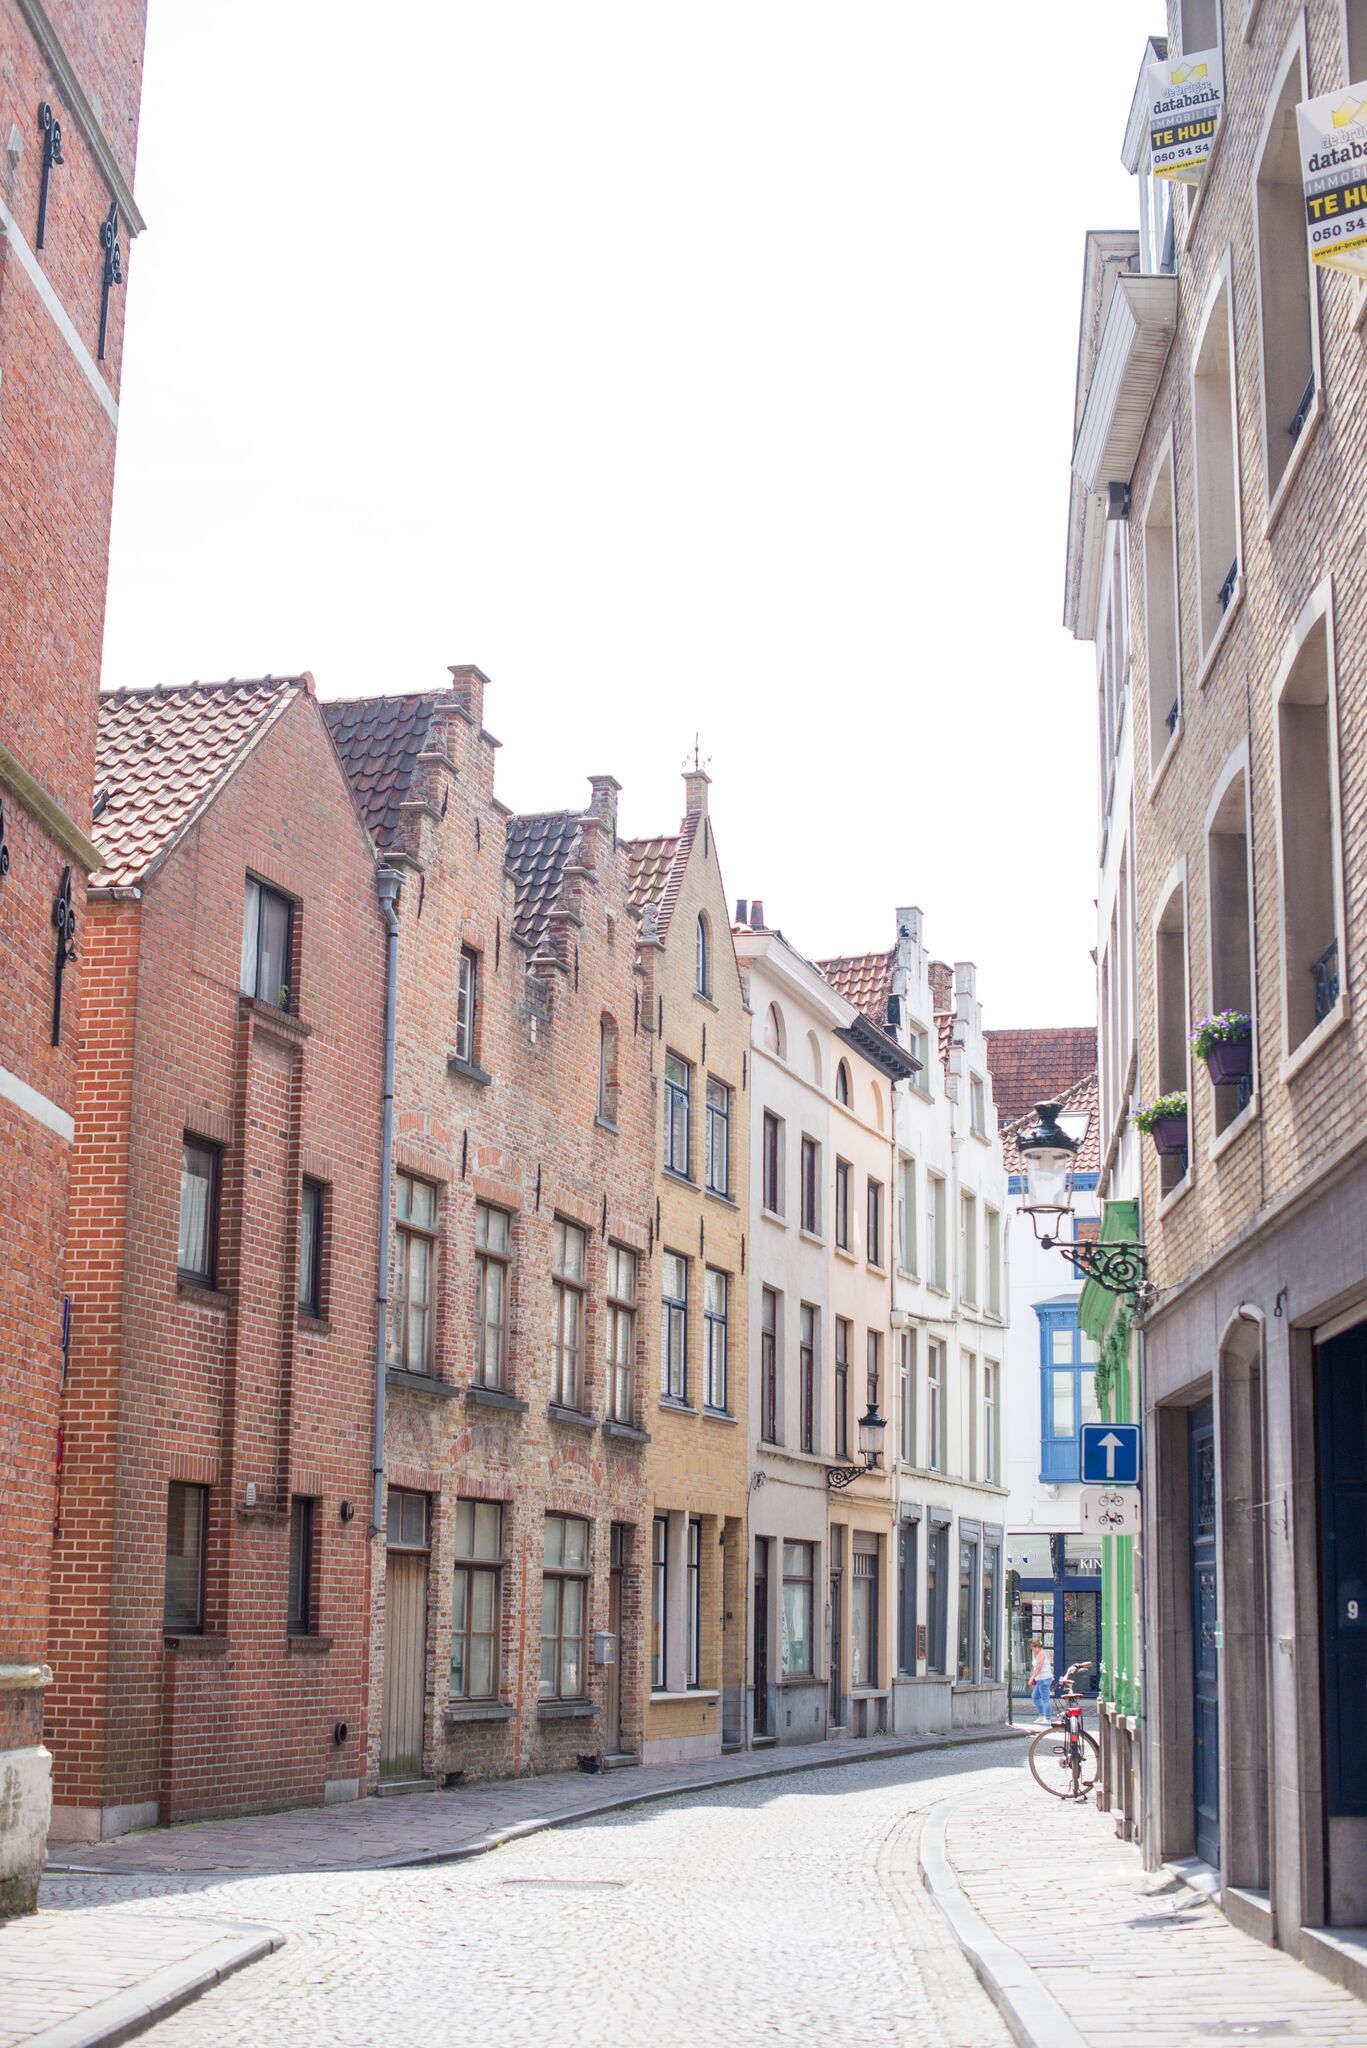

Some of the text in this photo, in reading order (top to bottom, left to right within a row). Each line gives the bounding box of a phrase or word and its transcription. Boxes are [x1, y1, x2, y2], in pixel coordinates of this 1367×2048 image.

[1153, 88, 1220, 114] databank
[1152, 130, 1174, 147] TE
[1154, 143, 1210, 164] 050 34 34
[1309, 193, 1339, 218] TE
[1312, 217, 1366, 243] 050 34
[1080, 1558, 1102, 1569] KIN
[1347, 1600, 1359, 1619] 9
